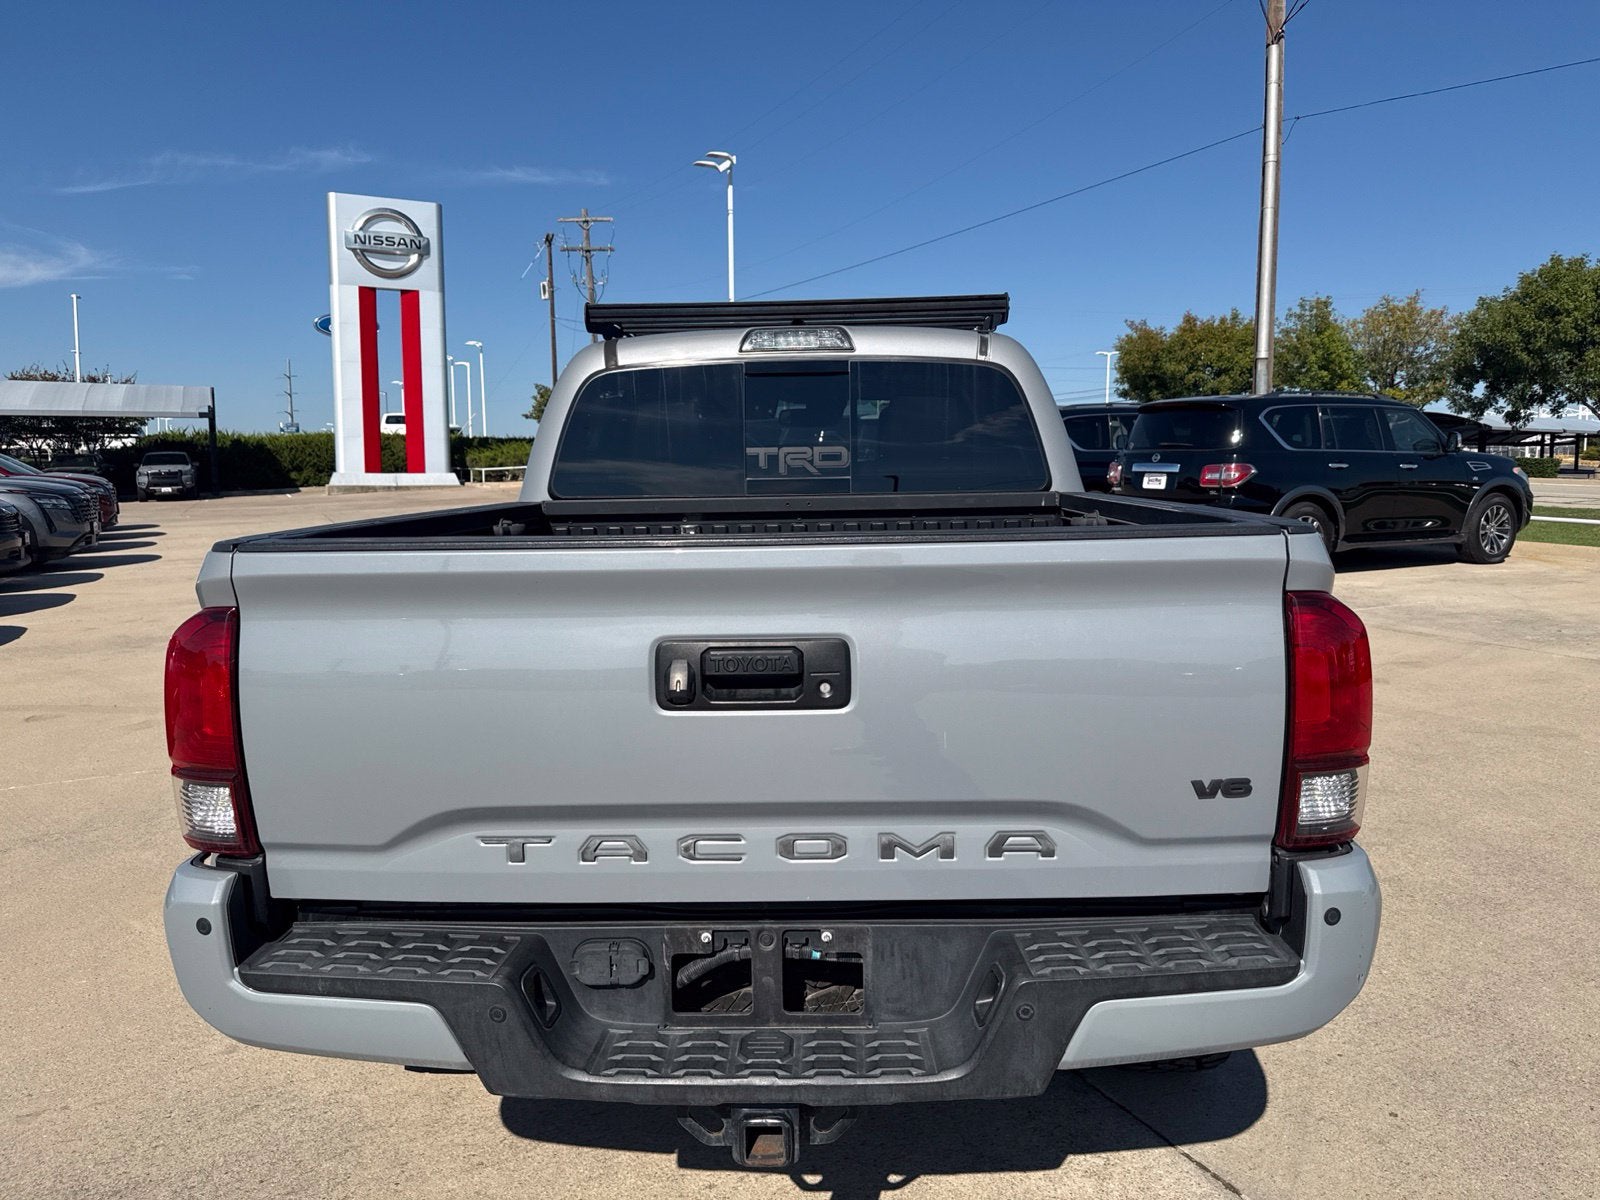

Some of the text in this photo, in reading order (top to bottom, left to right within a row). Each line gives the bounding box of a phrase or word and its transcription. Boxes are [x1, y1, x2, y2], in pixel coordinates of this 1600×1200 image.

[353, 233, 422, 250] NISSAN
[745, 446, 851, 475] TRD
[710, 655, 795, 673] TOYOTA
[1190, 777, 1253, 800] V6
[475, 830, 1058, 865] TACOMA
